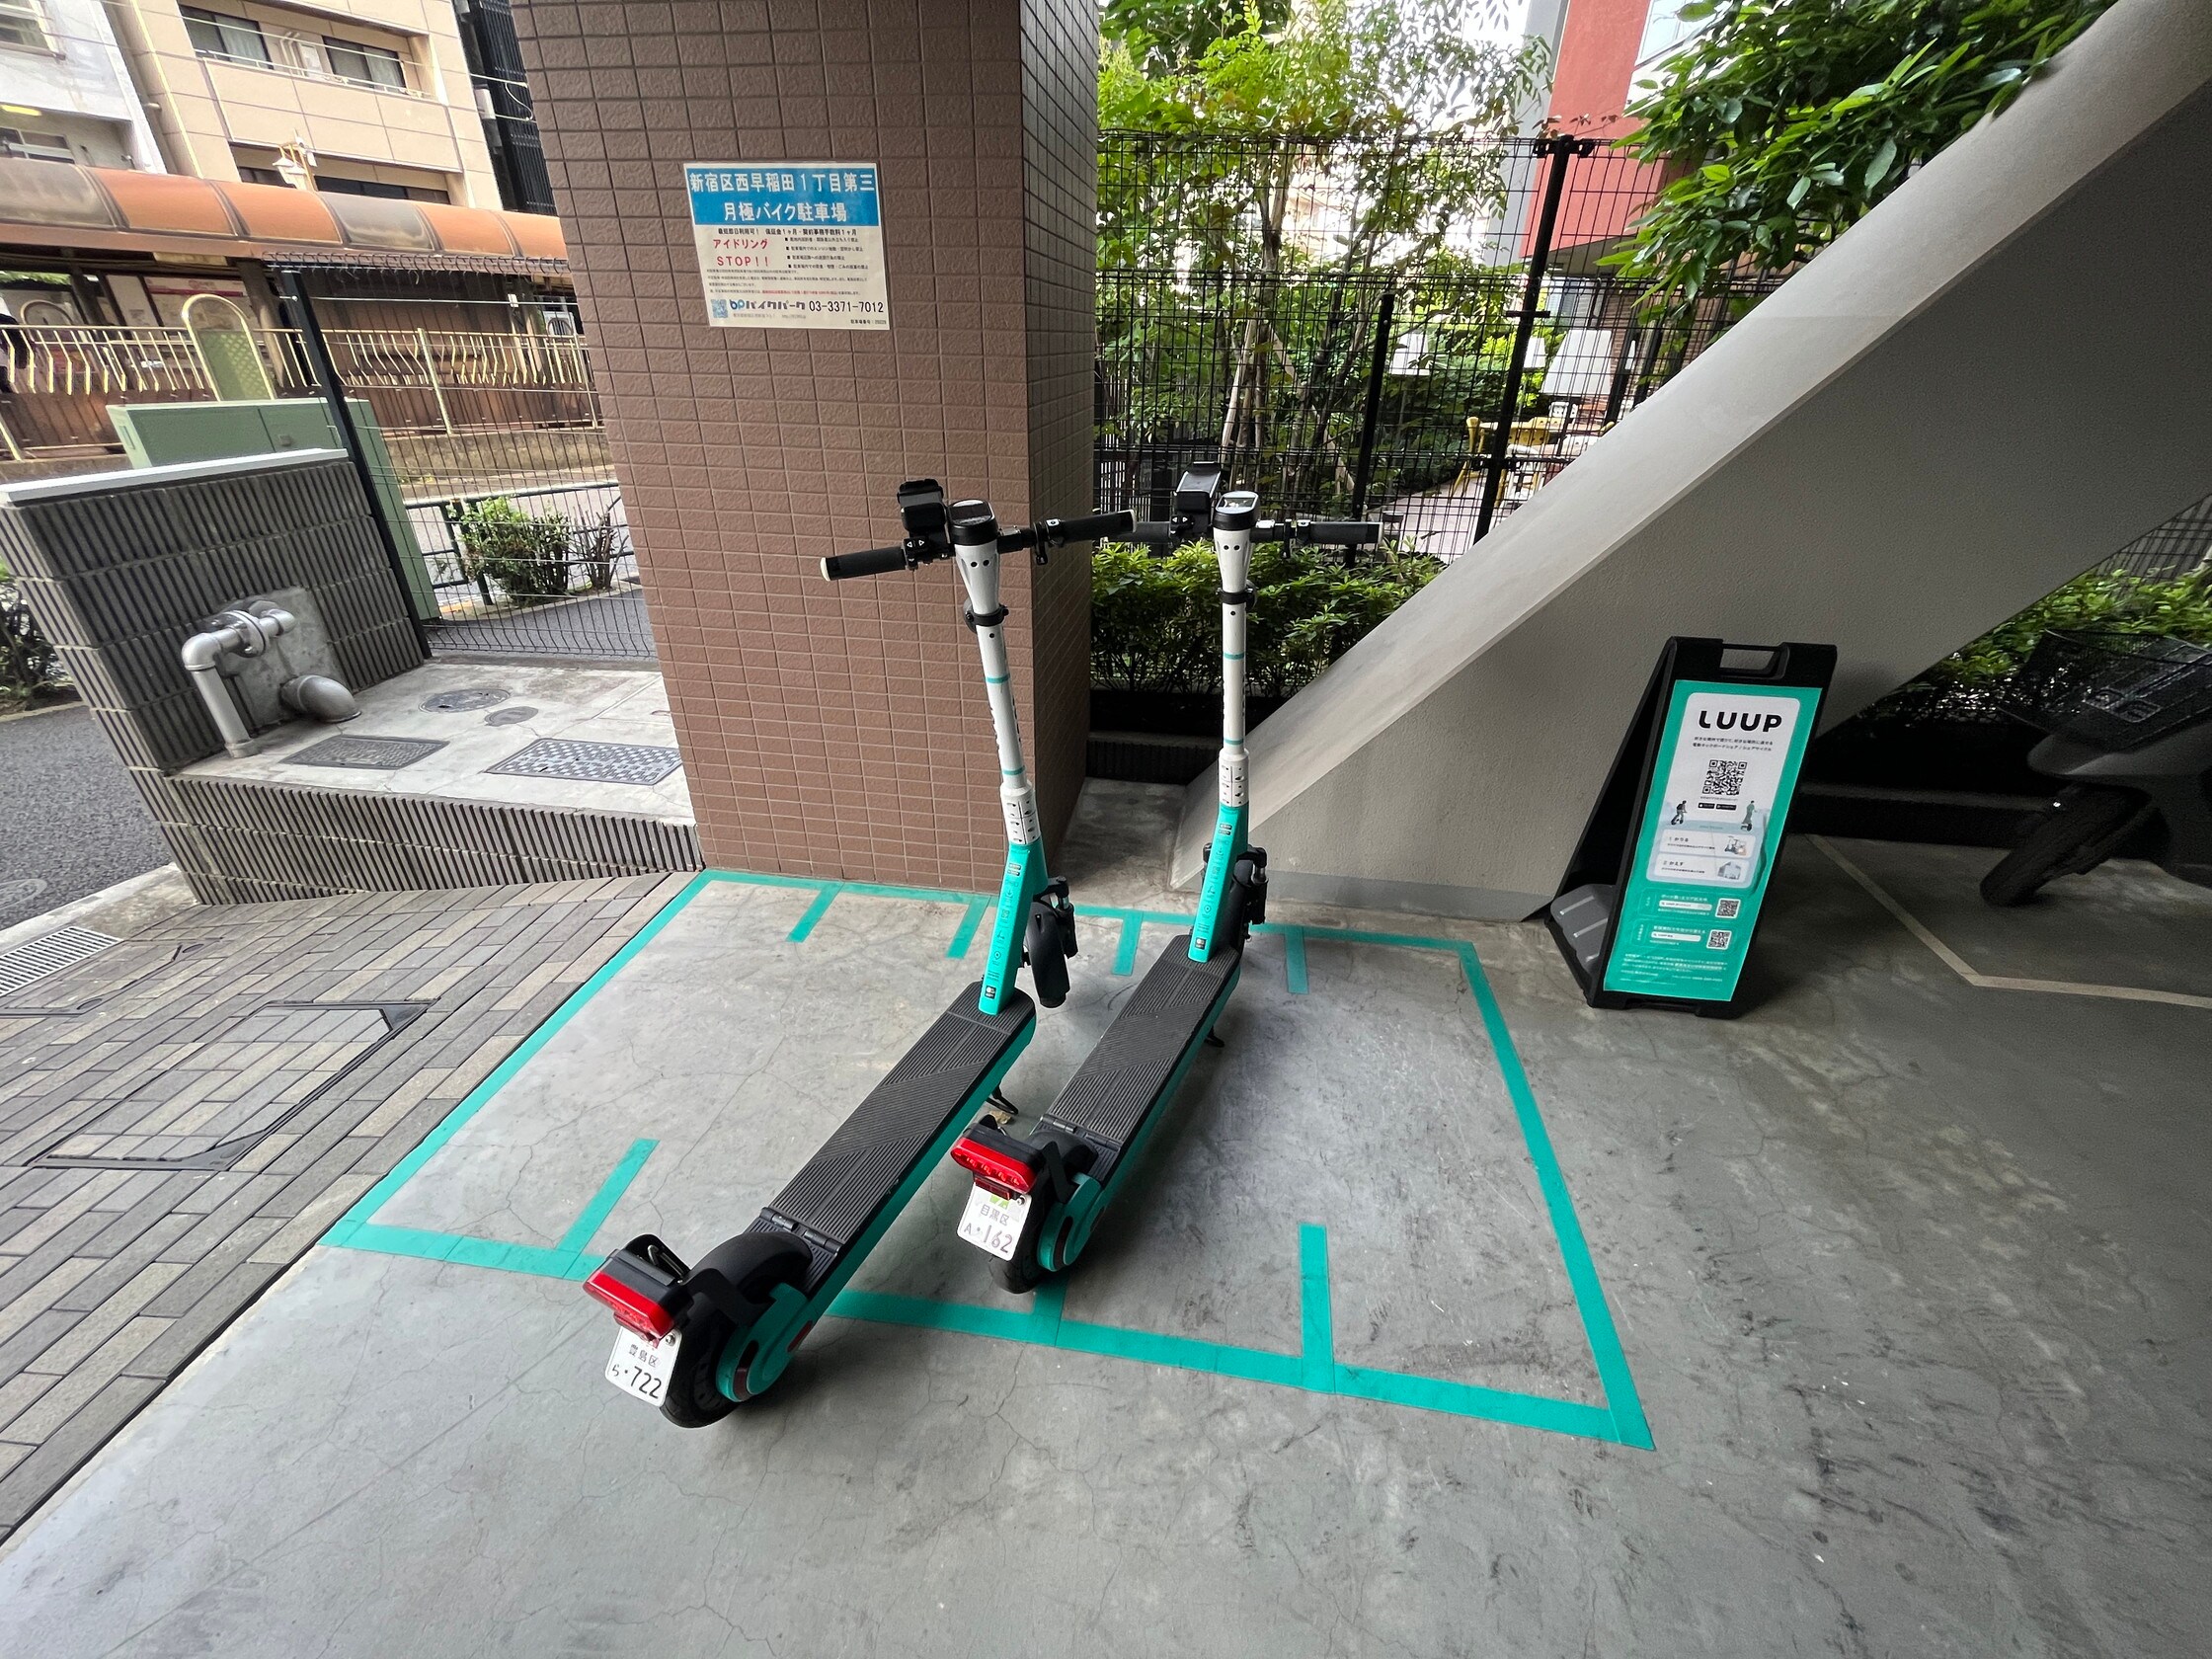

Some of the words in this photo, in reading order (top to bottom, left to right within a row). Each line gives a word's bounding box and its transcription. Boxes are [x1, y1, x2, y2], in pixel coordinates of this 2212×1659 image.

[724, 201, 847, 222] 月極バイク駐車場
[713, 238, 769, 250] アイドリング
[809, 300, 885, 313] 03-3371-7012
[1698, 710, 1782, 733] LUUP
[981, 1204, 1009, 1226] 目黒区
[628, 1344, 659, 1369] 豊島区
